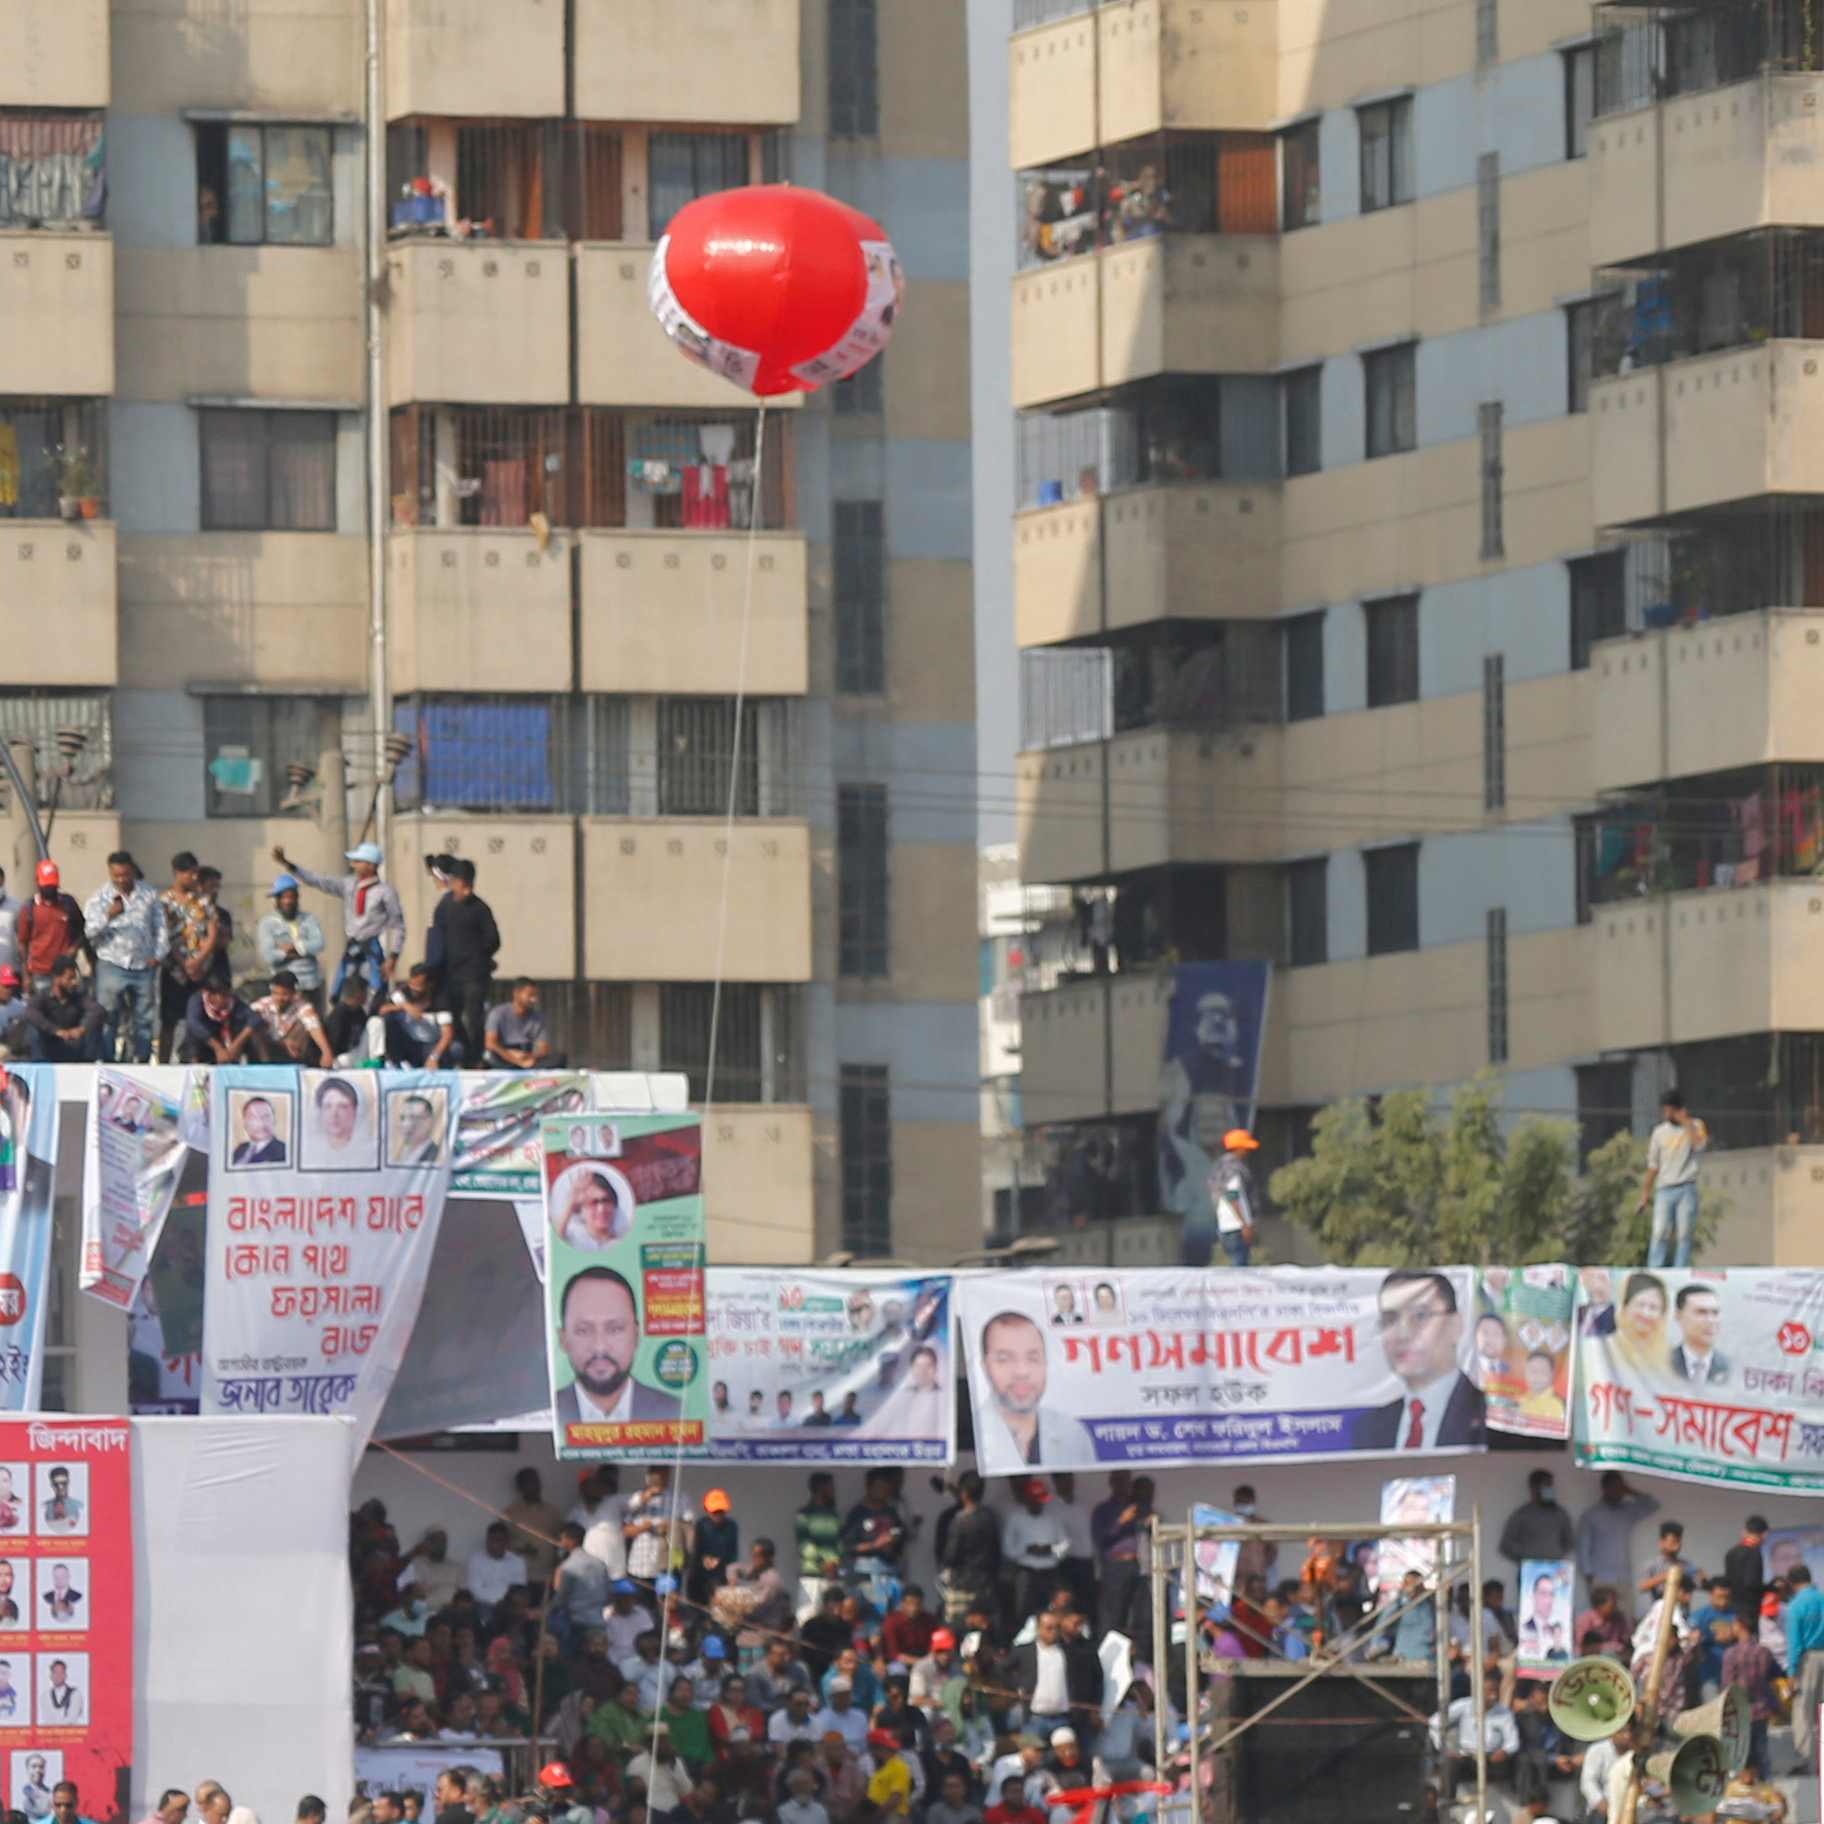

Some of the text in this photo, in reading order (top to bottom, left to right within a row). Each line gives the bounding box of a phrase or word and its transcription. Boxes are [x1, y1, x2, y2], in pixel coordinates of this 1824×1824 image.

[226, 1194, 425, 1237] বাংলাদেশ যাবে
[224, 1243, 351, 1281] কোন পথে
[270, 1283, 384, 1325] ফয়সালা
[1061, 1325, 1358, 1375] গণসমাবেশ
[216, 1373, 357, 1415] জনাব তারেক
[25, 1421, 129, 1453] জিন্দাবাদ
